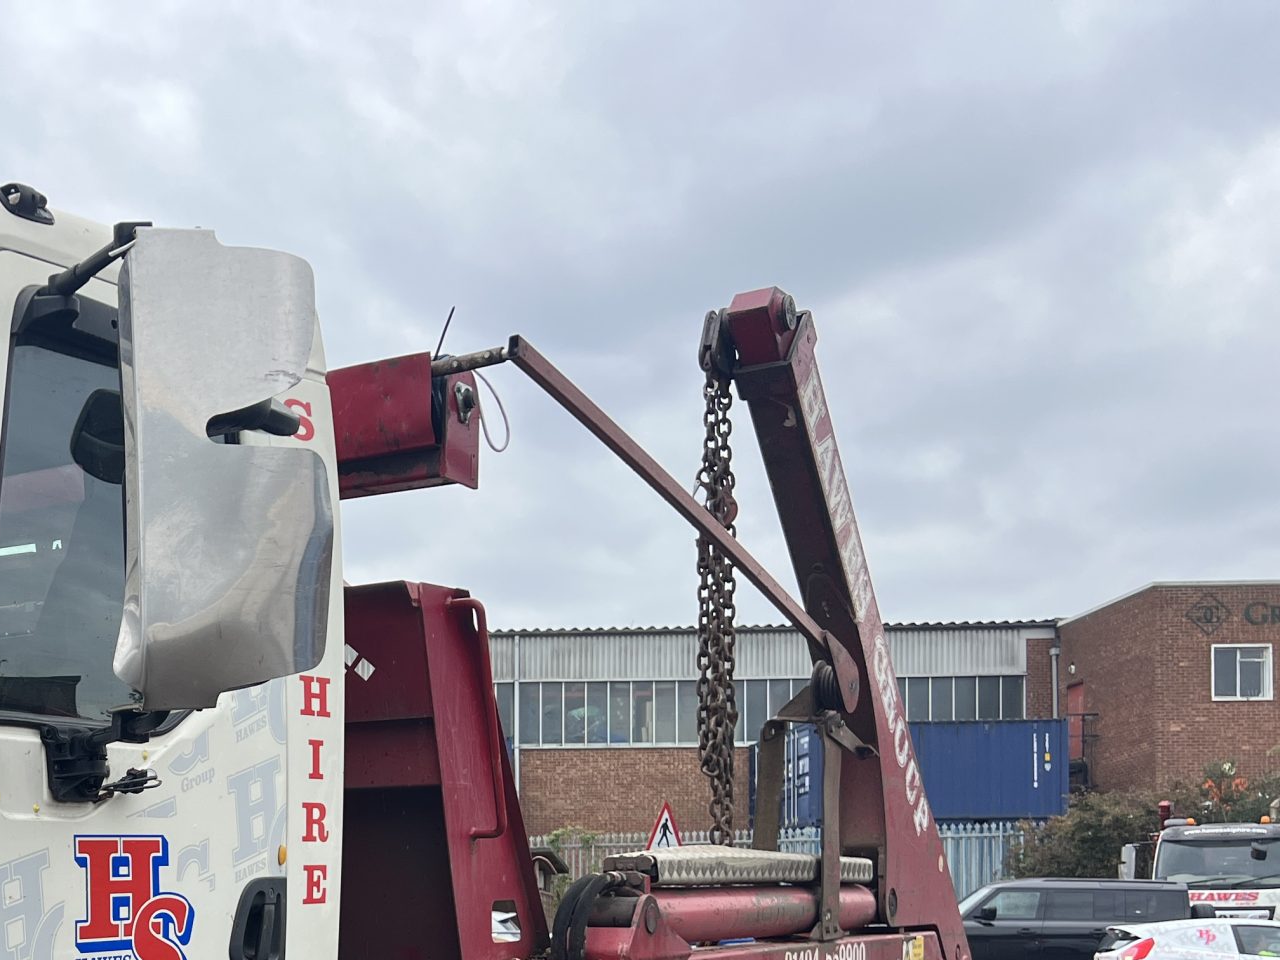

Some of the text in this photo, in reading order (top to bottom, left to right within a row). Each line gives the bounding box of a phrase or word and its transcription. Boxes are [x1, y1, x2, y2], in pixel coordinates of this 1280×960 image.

[234, 715, 268, 744] HAWES
[180, 766, 216, 793] Group
[298, 673, 332, 905] HIRE
[234, 857, 267, 885] HAWES
[1189, 891, 1260, 902] HAWES
